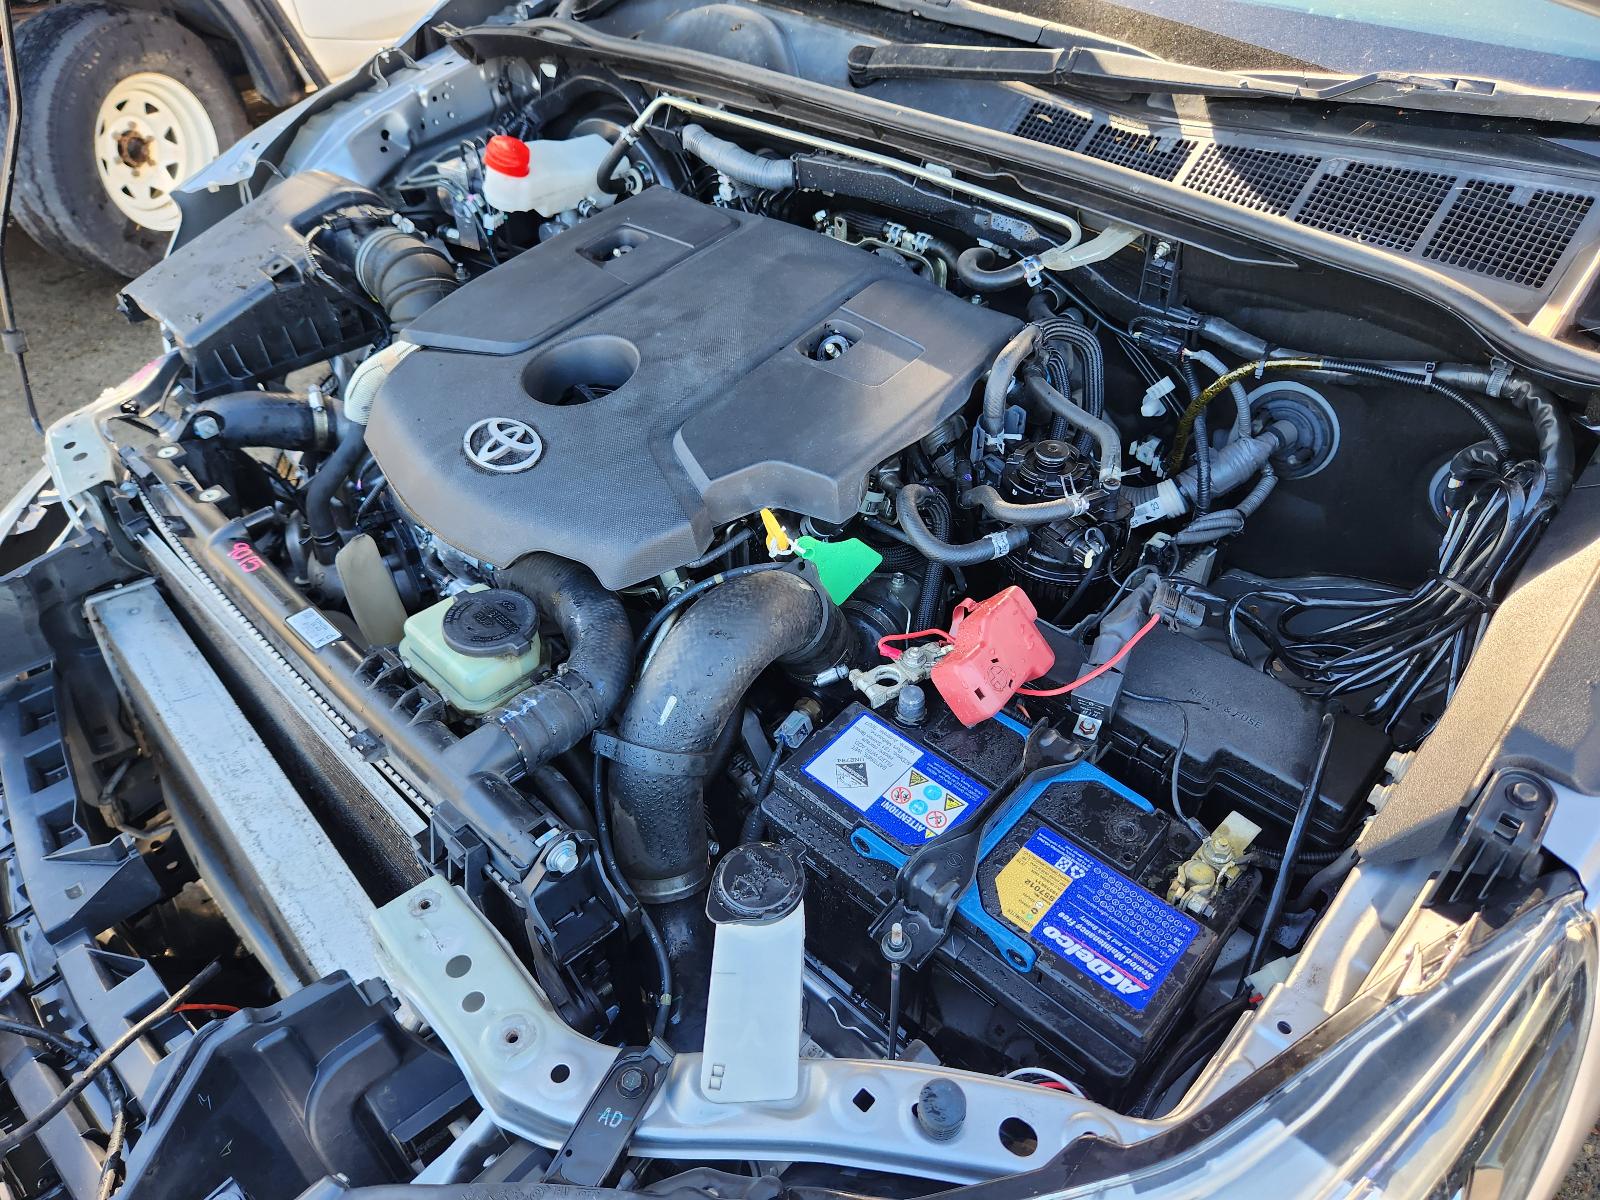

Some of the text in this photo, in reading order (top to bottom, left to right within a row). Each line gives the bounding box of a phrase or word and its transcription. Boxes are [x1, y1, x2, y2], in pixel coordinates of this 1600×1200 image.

[1188, 687, 1221, 707] RELAY
[1232, 711, 1262, 728] FUSE
[879, 798, 926, 833] ATTENTION!
[1057, 911, 1076, 928] Free
[1042, 924, 1143, 996] ACDelco
[1074, 921, 1126, 962] Maintenance
[1078, 913, 1159, 973] PREMIUM Car and Truck Battery
[1124, 956, 1154, 982] Sealed
